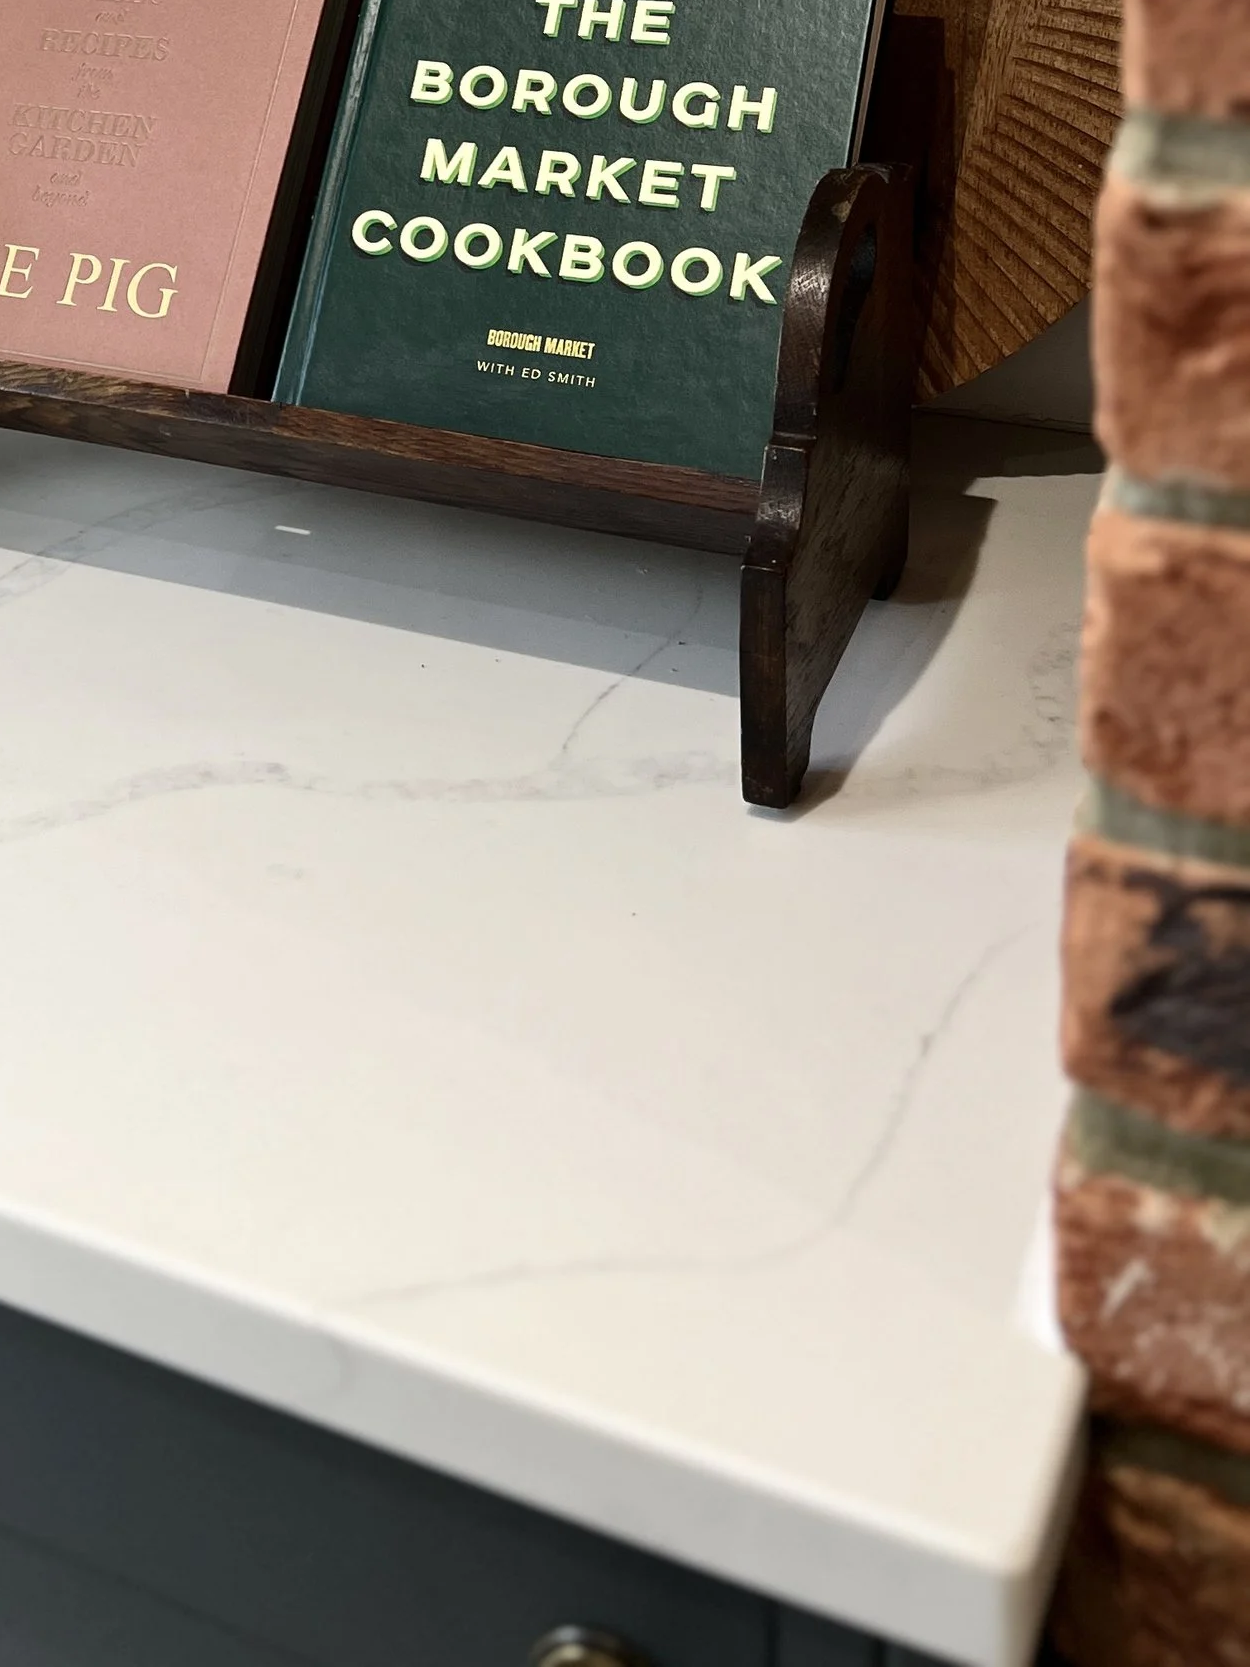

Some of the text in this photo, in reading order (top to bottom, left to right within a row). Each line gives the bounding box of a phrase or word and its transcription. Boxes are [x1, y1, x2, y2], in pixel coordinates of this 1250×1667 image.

[40, 28, 171, 62] RECIPES
[410, 59, 779, 134] BOROUGH
[6, 103, 159, 140] KITCHEN
[8, 131, 144, 168] GARDEN
[419, 137, 738, 213] MARKET
[351, 209, 783, 305] COOKBOOK
[55, 252, 180, 319] PIG
[487, 329, 596, 360] BOROUGH MARKET
[477, 360, 596, 388] WITH ED SMITH
